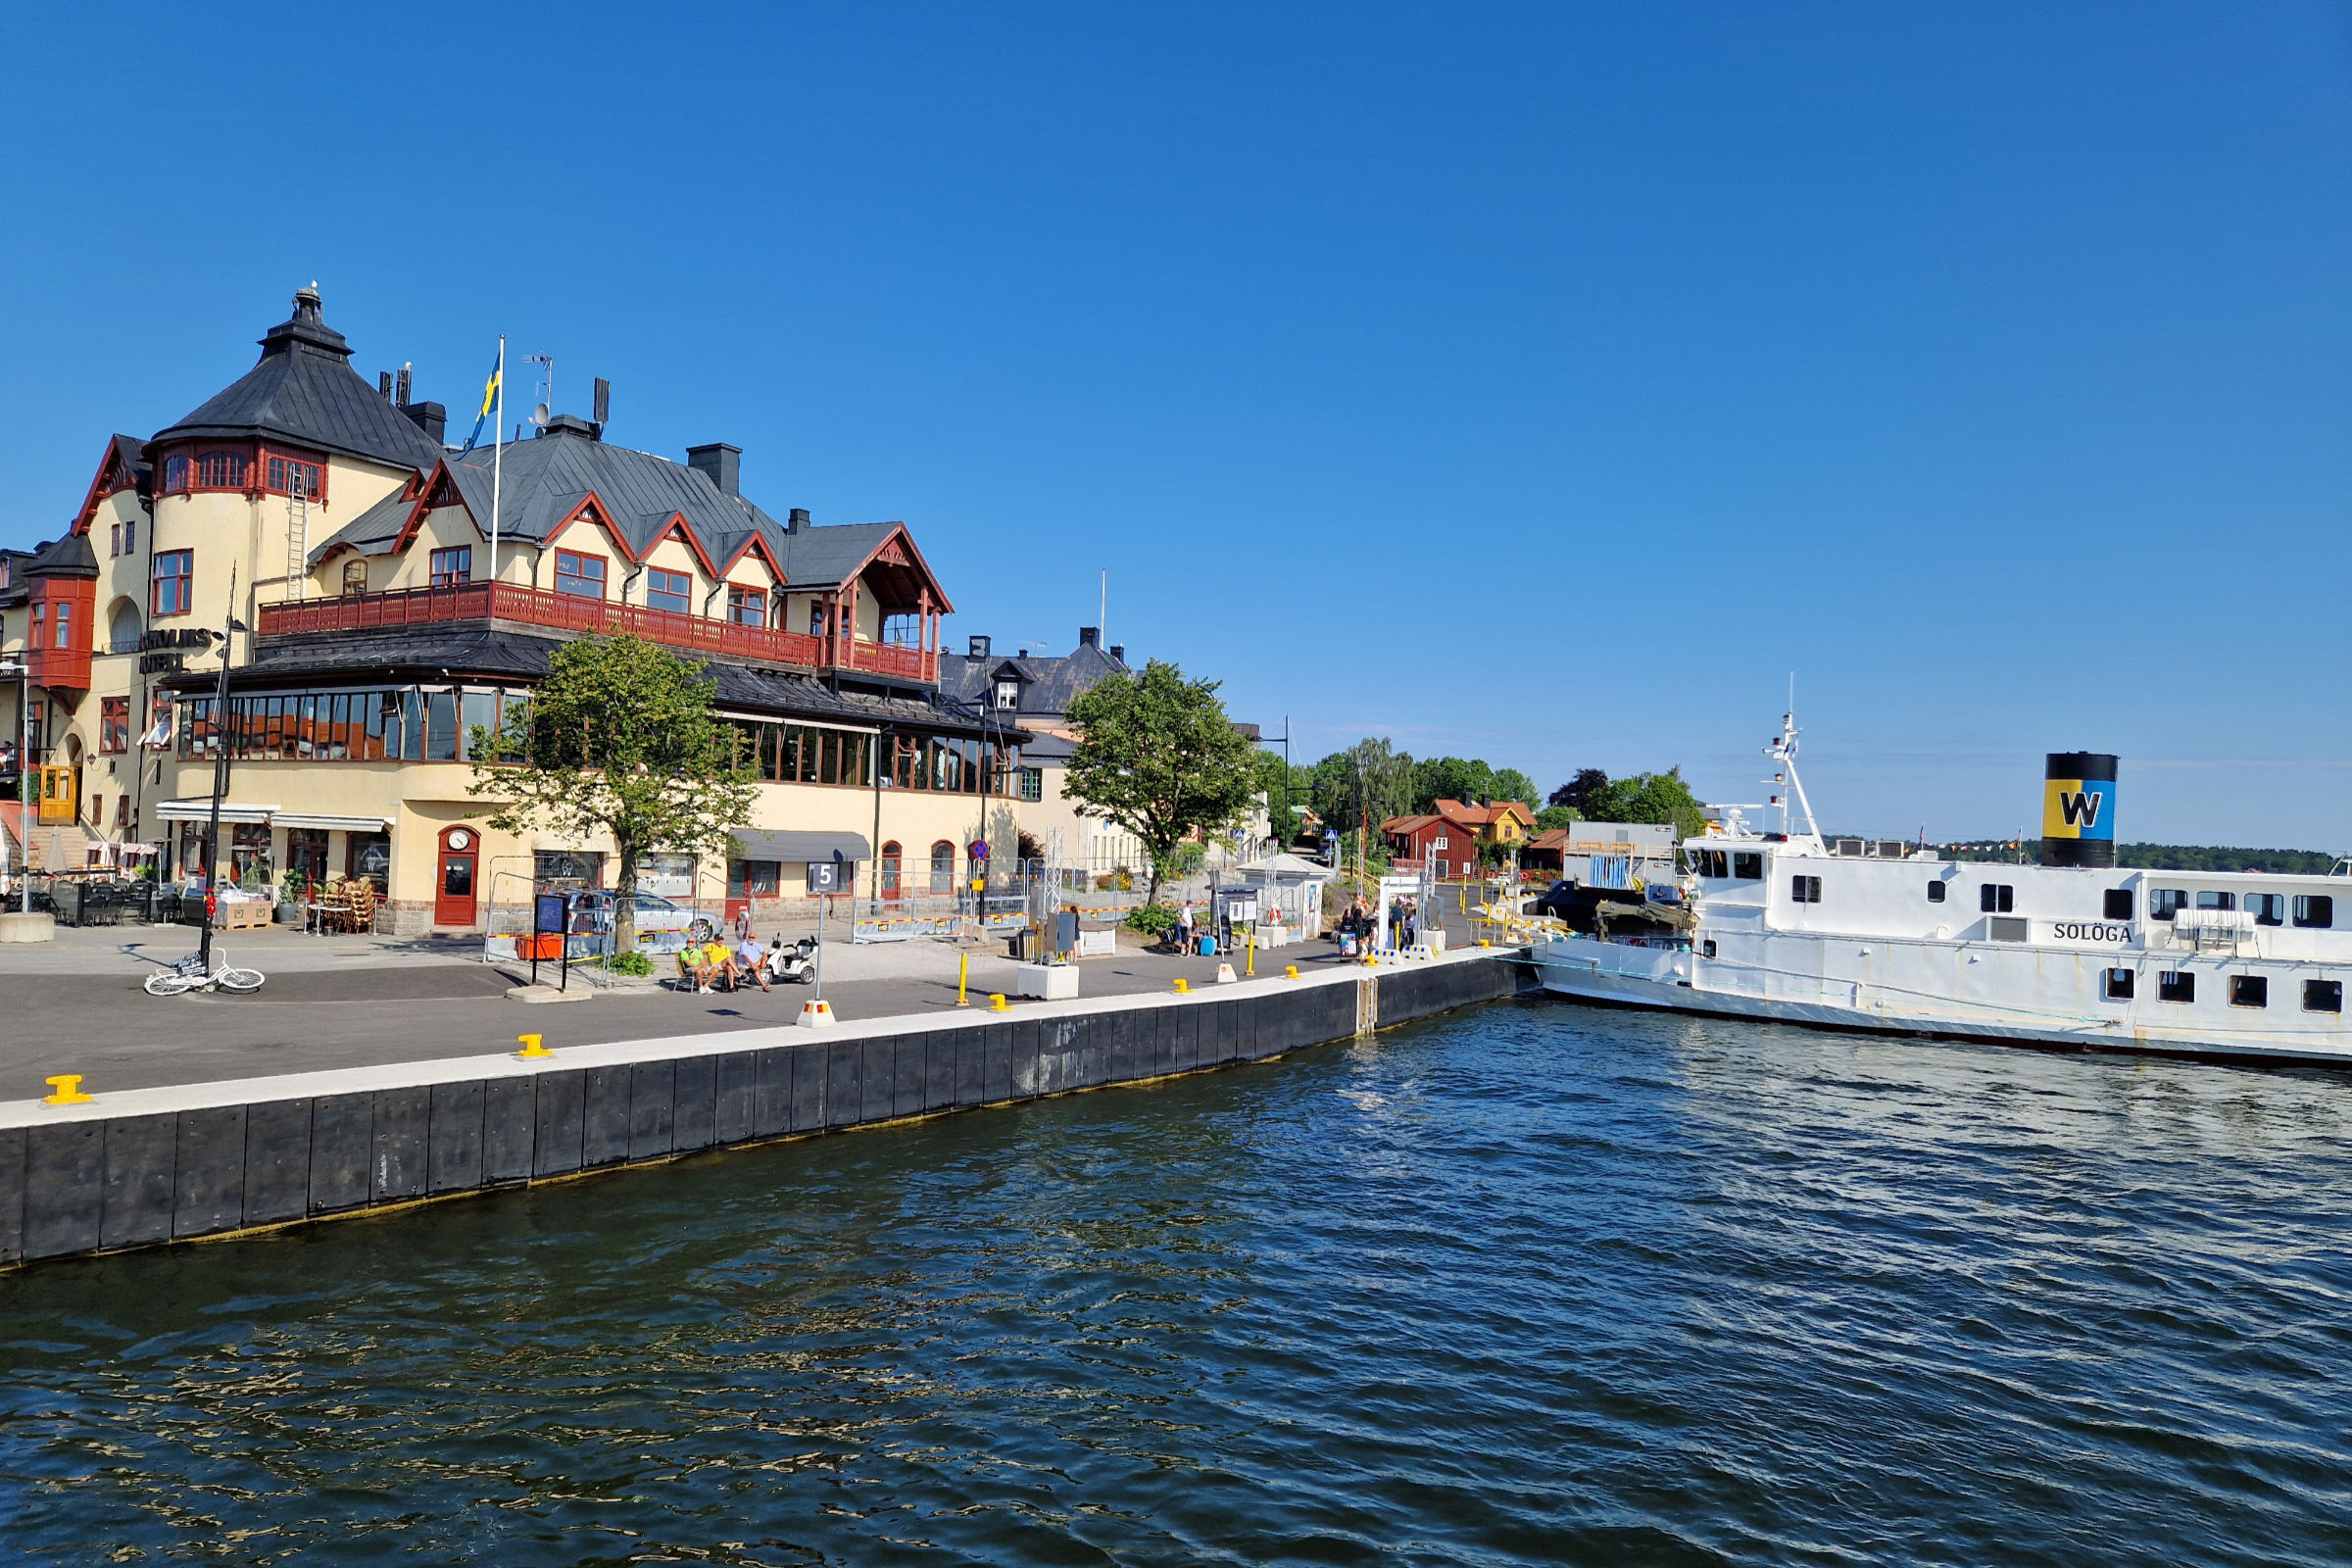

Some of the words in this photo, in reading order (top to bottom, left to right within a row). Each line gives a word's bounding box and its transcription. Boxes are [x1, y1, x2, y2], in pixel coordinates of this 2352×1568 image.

[2059, 792, 2102, 828] W
[819, 864, 832, 885] 5
[2054, 922, 2132, 943] SOLÖGA
